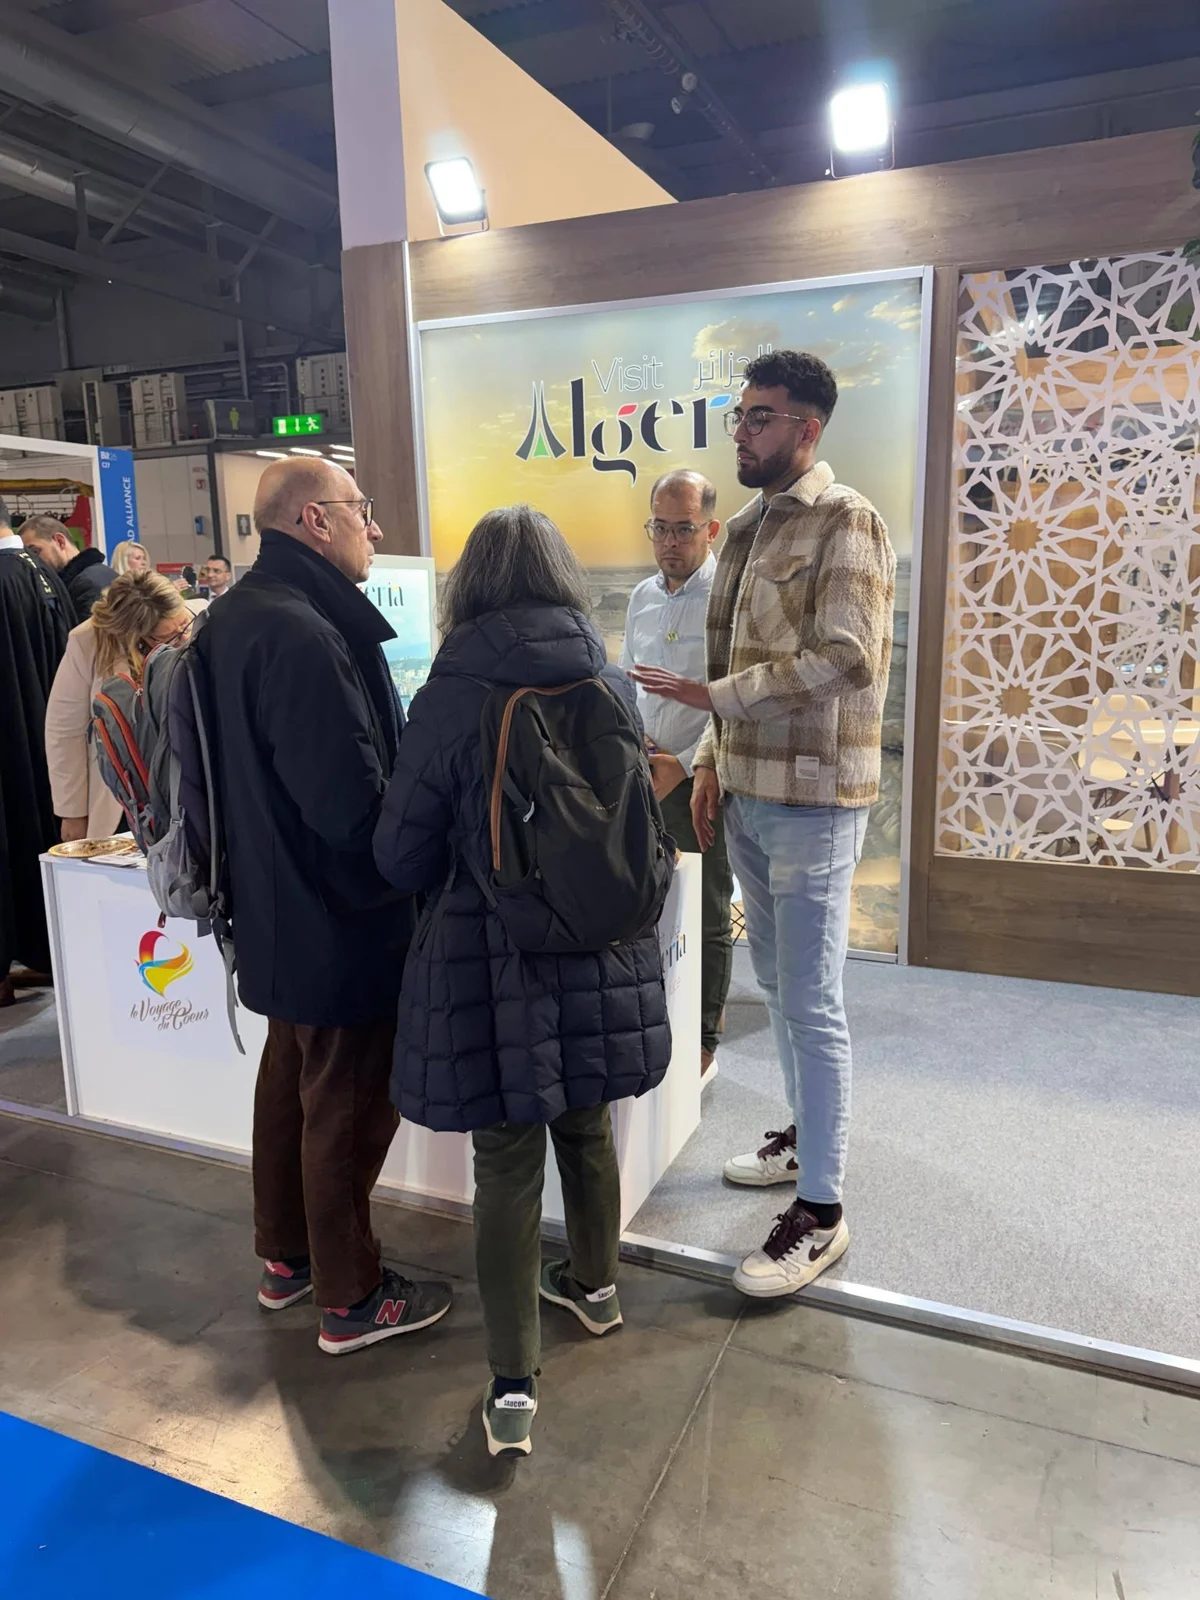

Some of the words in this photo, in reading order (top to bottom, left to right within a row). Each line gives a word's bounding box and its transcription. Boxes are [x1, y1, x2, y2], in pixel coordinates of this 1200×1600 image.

[592, 354, 663, 393] Visit
[514, 377, 741, 487] Alger
[122, 476, 135, 527] ALLIANCE
[139, 997, 182, 1021] Voyage
[375, 1299, 406, 1325] N
